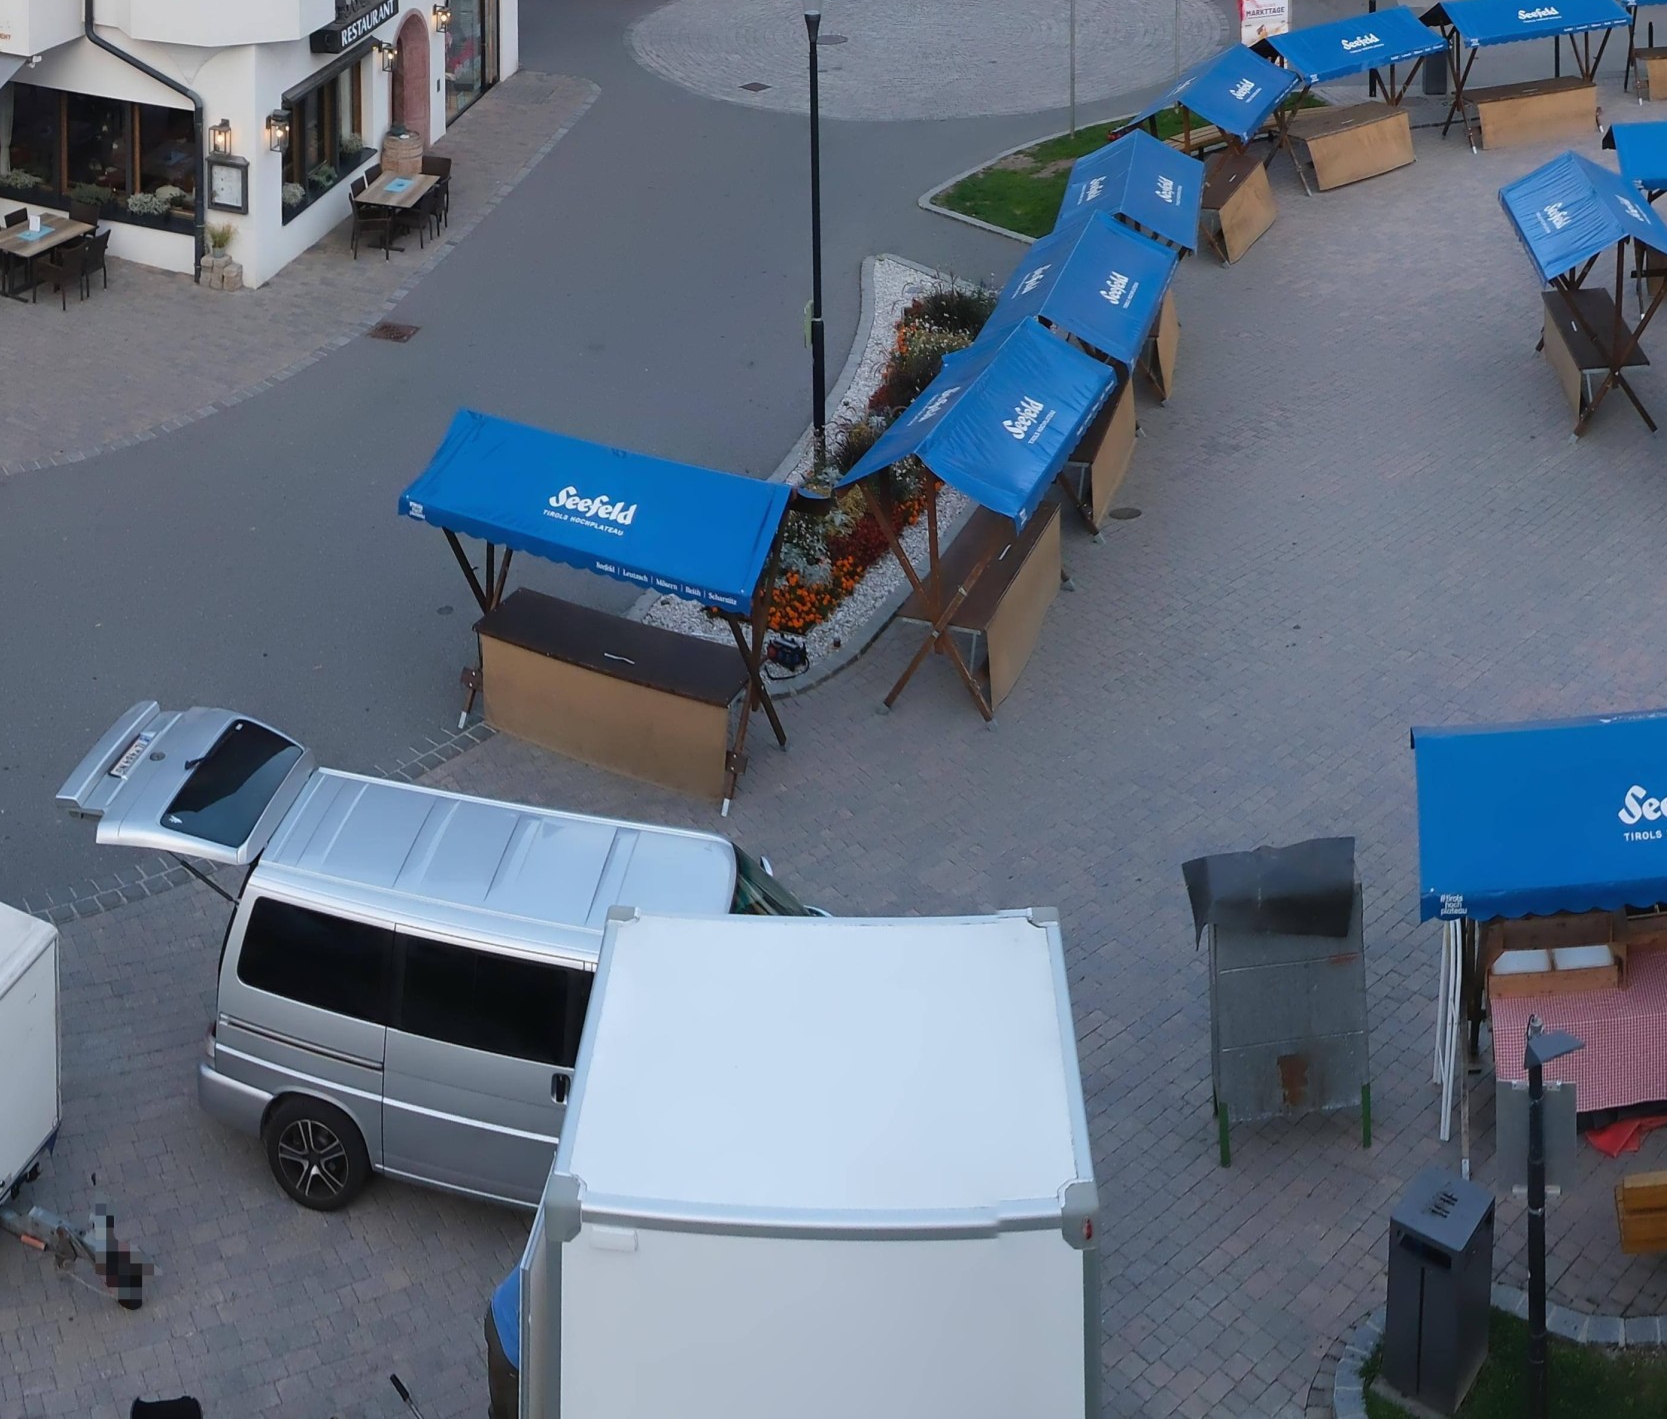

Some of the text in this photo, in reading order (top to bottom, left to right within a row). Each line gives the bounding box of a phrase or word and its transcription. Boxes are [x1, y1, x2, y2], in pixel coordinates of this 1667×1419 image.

[1246, 6, 1285, 17] MARKTTAGE
[548, 485, 637, 526] Seefeld
[1623, 830, 1662, 842] TIROLS
